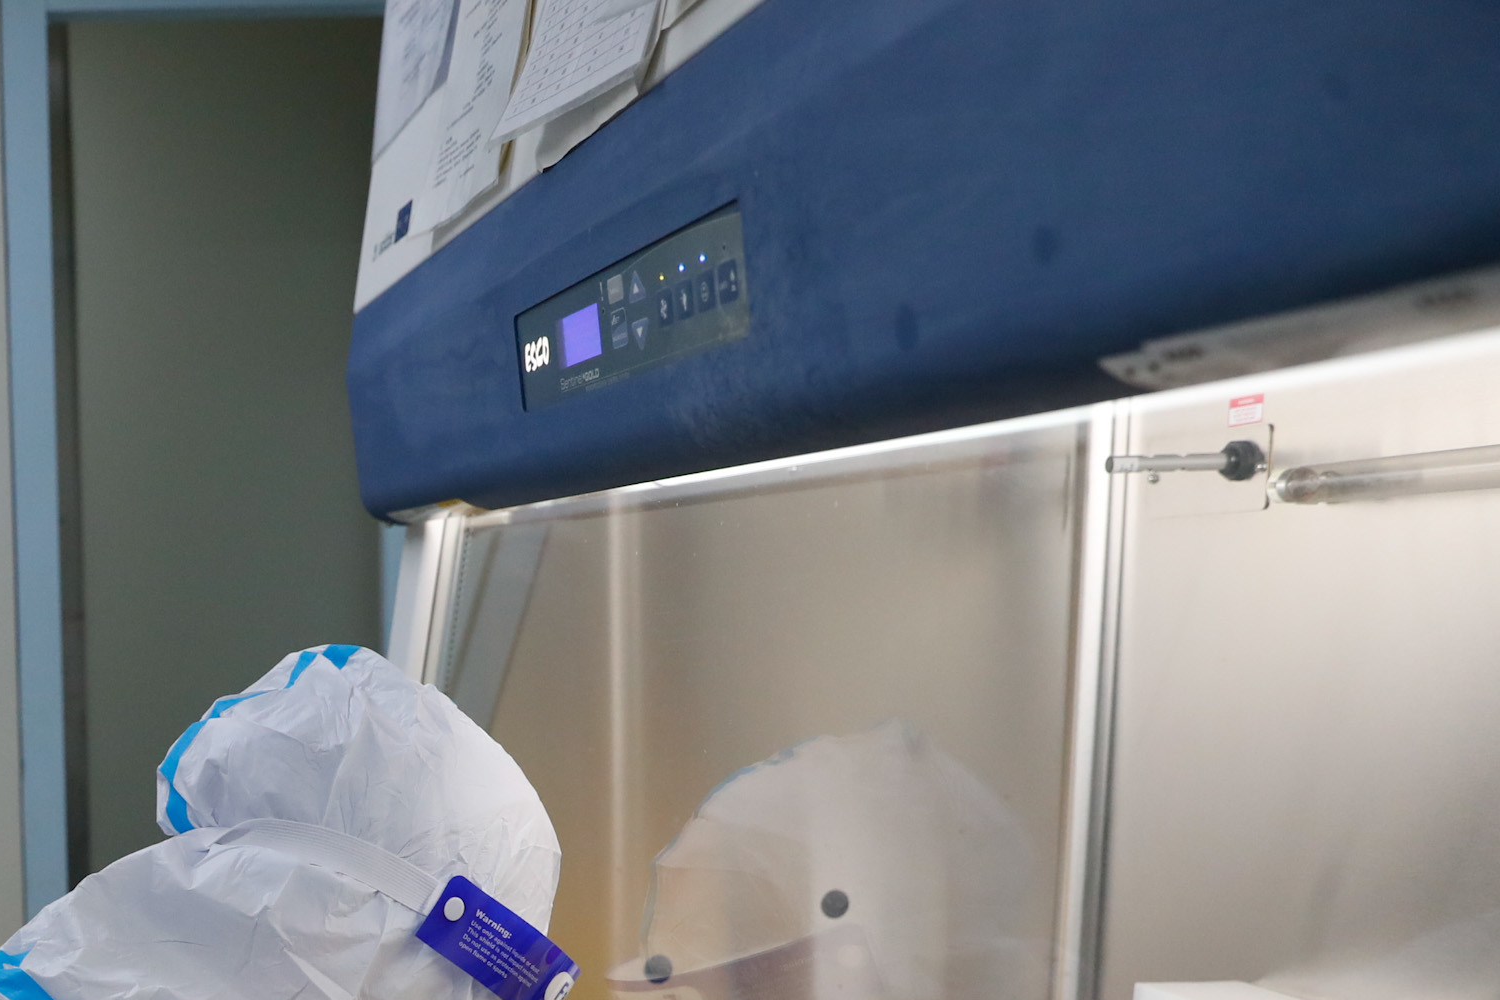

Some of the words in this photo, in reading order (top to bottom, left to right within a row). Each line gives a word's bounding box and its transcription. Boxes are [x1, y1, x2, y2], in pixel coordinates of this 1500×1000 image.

[471, 920, 481, 930] Use
[482, 927, 494, 939] only
[494, 937, 512, 952] against
[475, 909, 512, 939] Warning:
[458, 941, 472, 952] open
[473, 949, 487, 963] flame
[463, 934, 471, 942] Do
[471, 940, 481, 949] not
[468, 927, 478, 938] This
[479, 935, 495, 948] shield
[501, 951, 509, 959] not
